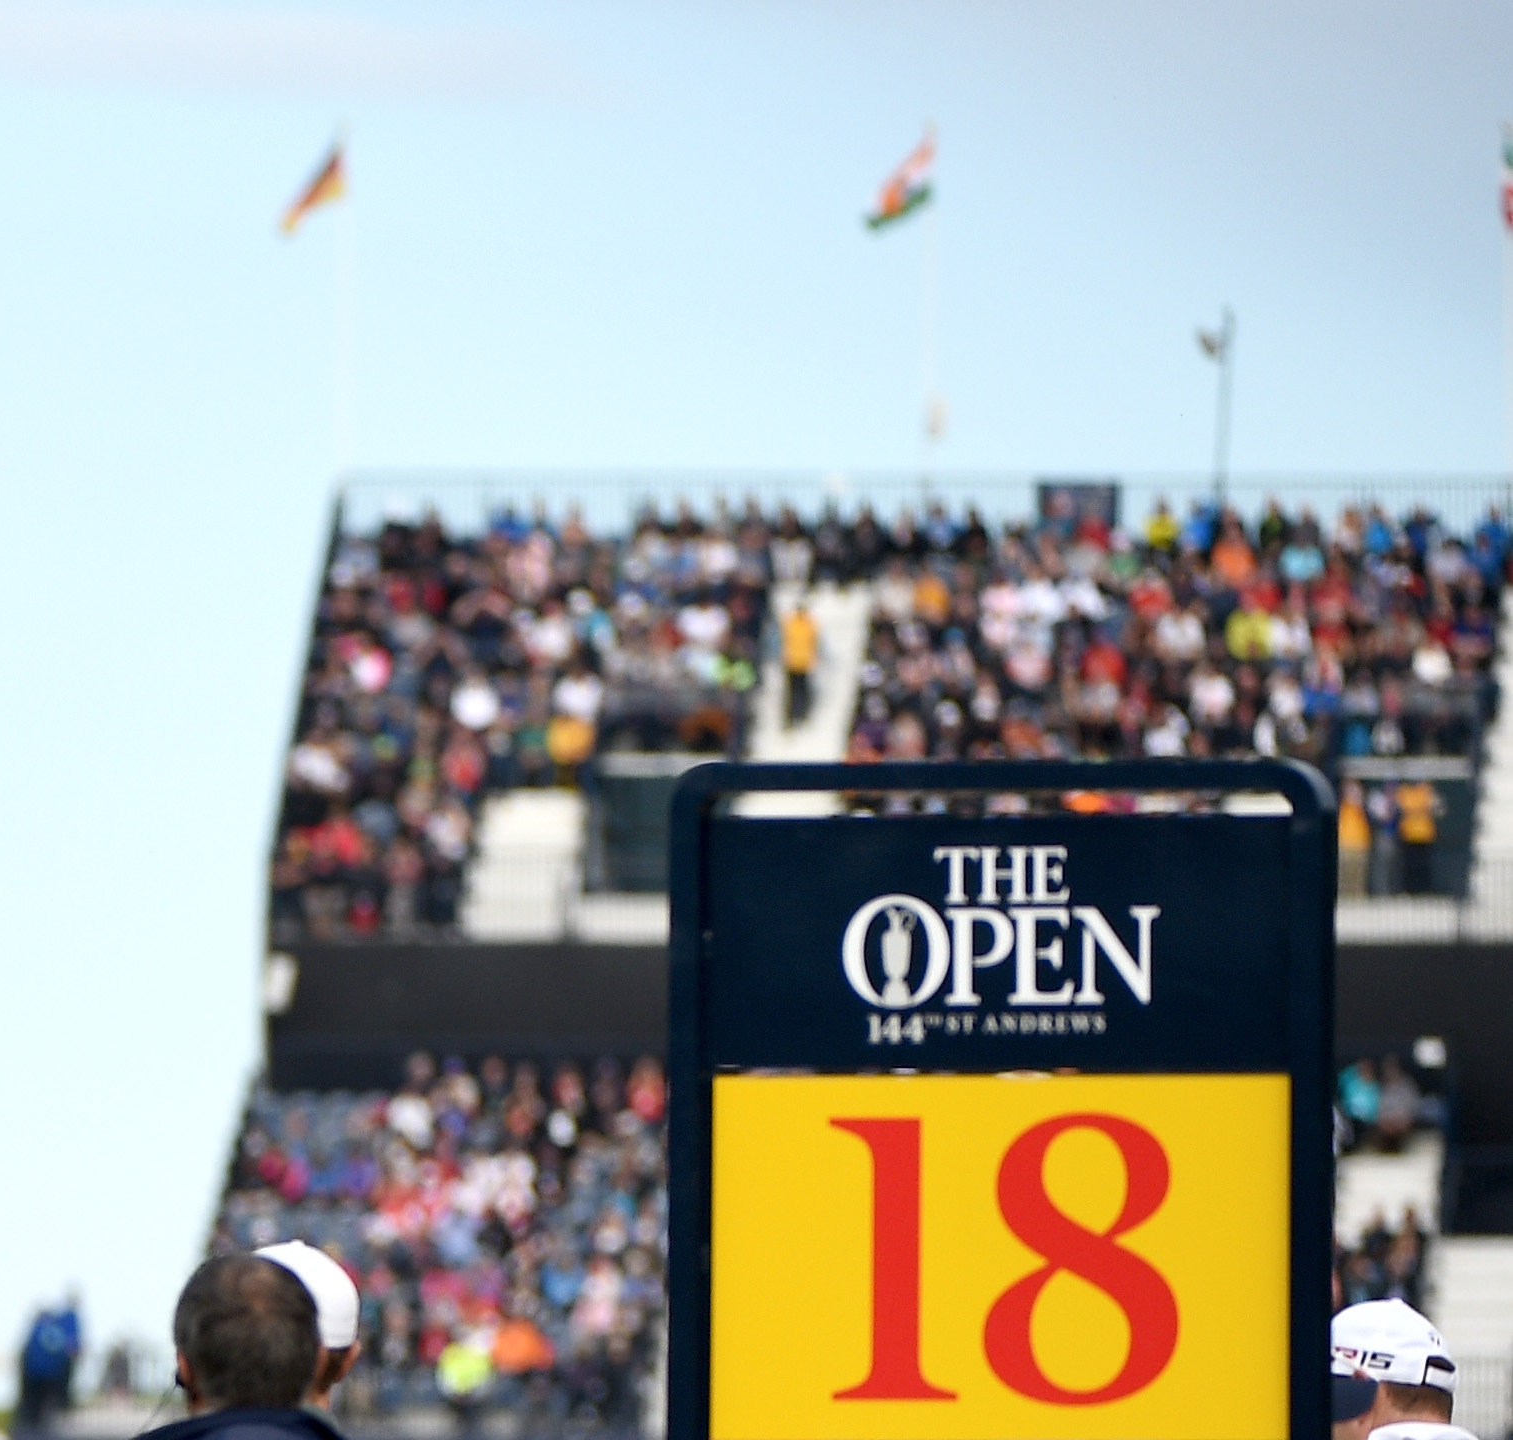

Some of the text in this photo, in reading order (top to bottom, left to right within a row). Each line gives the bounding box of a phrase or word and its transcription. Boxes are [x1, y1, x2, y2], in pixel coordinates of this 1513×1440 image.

[933, 845, 1070, 904] THE
[842, 893, 1161, 1010] OPEN
[945, 1014, 977, 1035] ST
[981, 1012, 1107, 1035] ANDREWS
[829, 1111, 1181, 1407] 18
